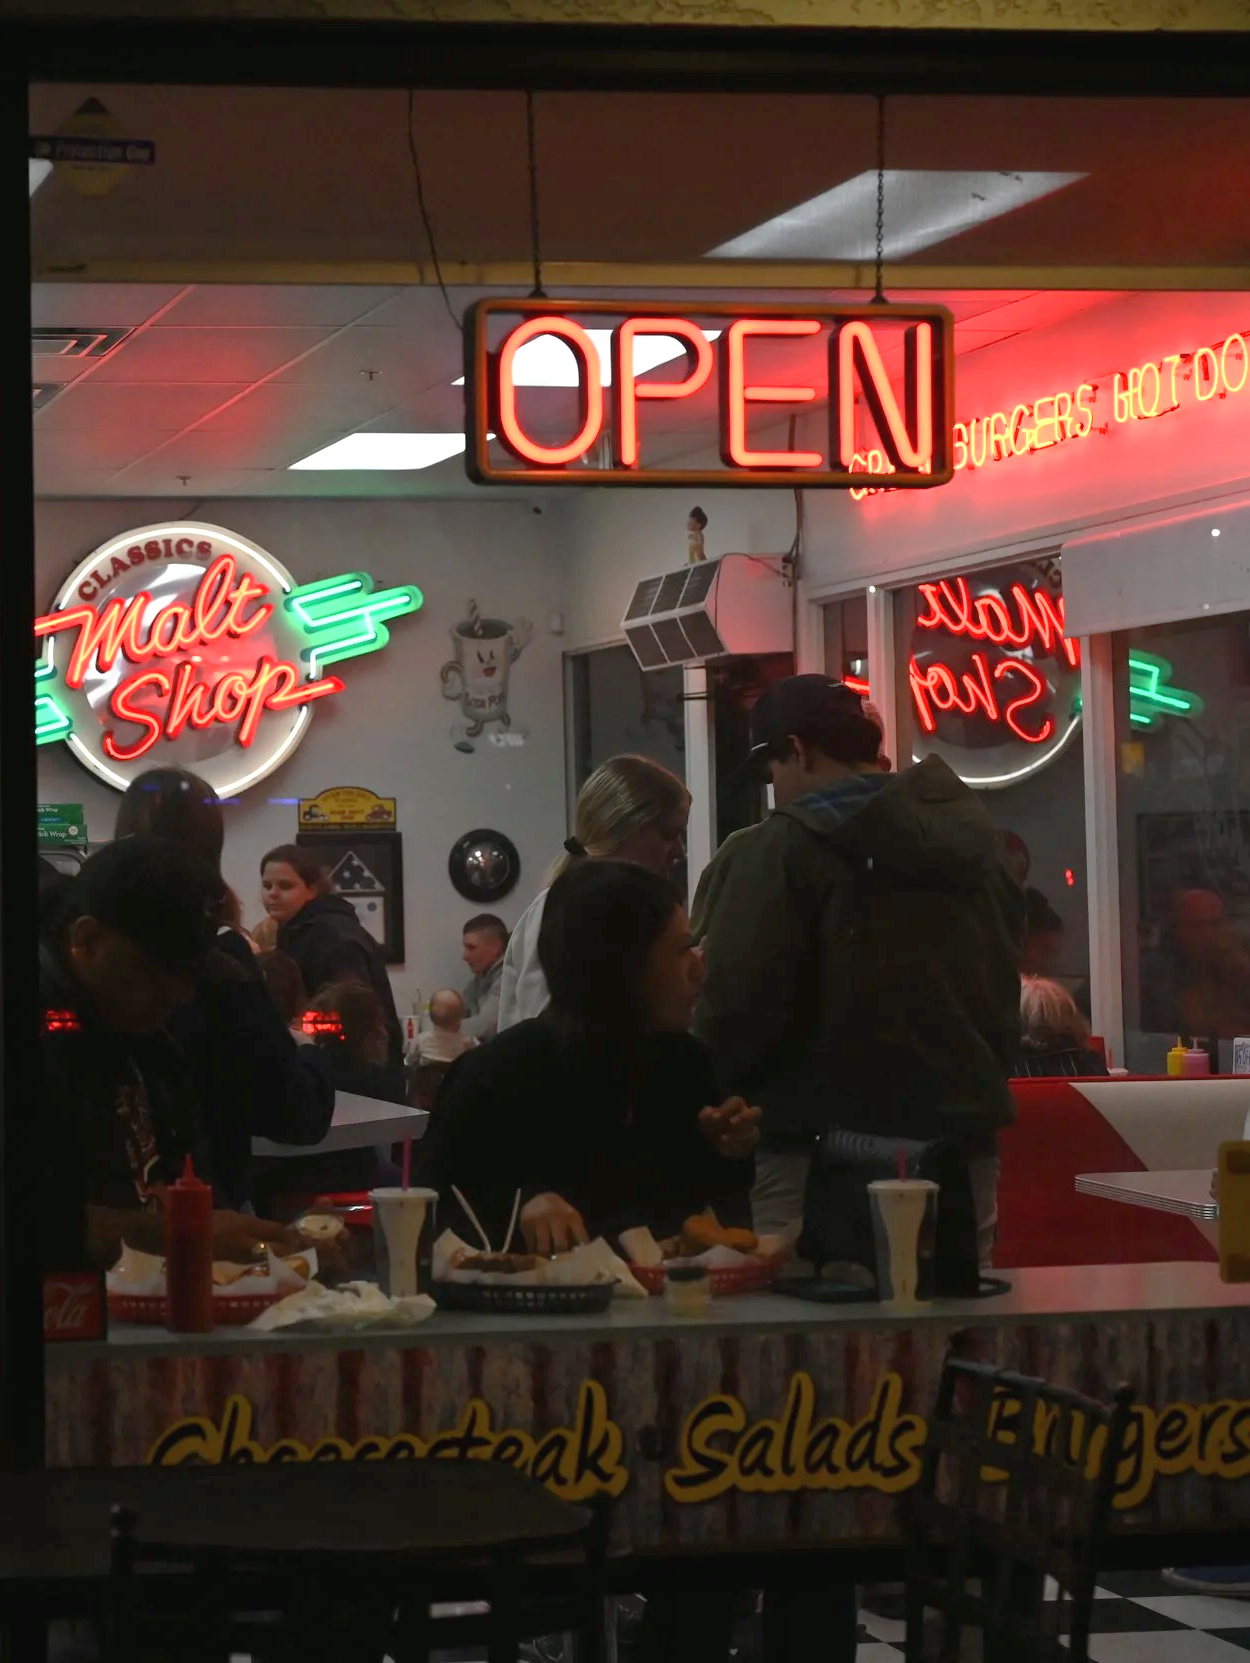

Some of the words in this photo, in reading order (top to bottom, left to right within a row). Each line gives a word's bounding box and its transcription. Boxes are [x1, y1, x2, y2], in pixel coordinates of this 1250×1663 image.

[499, 315, 932, 466] OPEN
[952, 383, 1093, 471] BURGERS
[1112, 354, 1182, 422] HOT
[35, 554, 274, 689] Malt
[77, 537, 213, 602] CLASSICS
[102, 654, 346, 762] Shop
[663, 1371, 931, 1504] Salads
[978, 1383, 1250, 1512] gers
